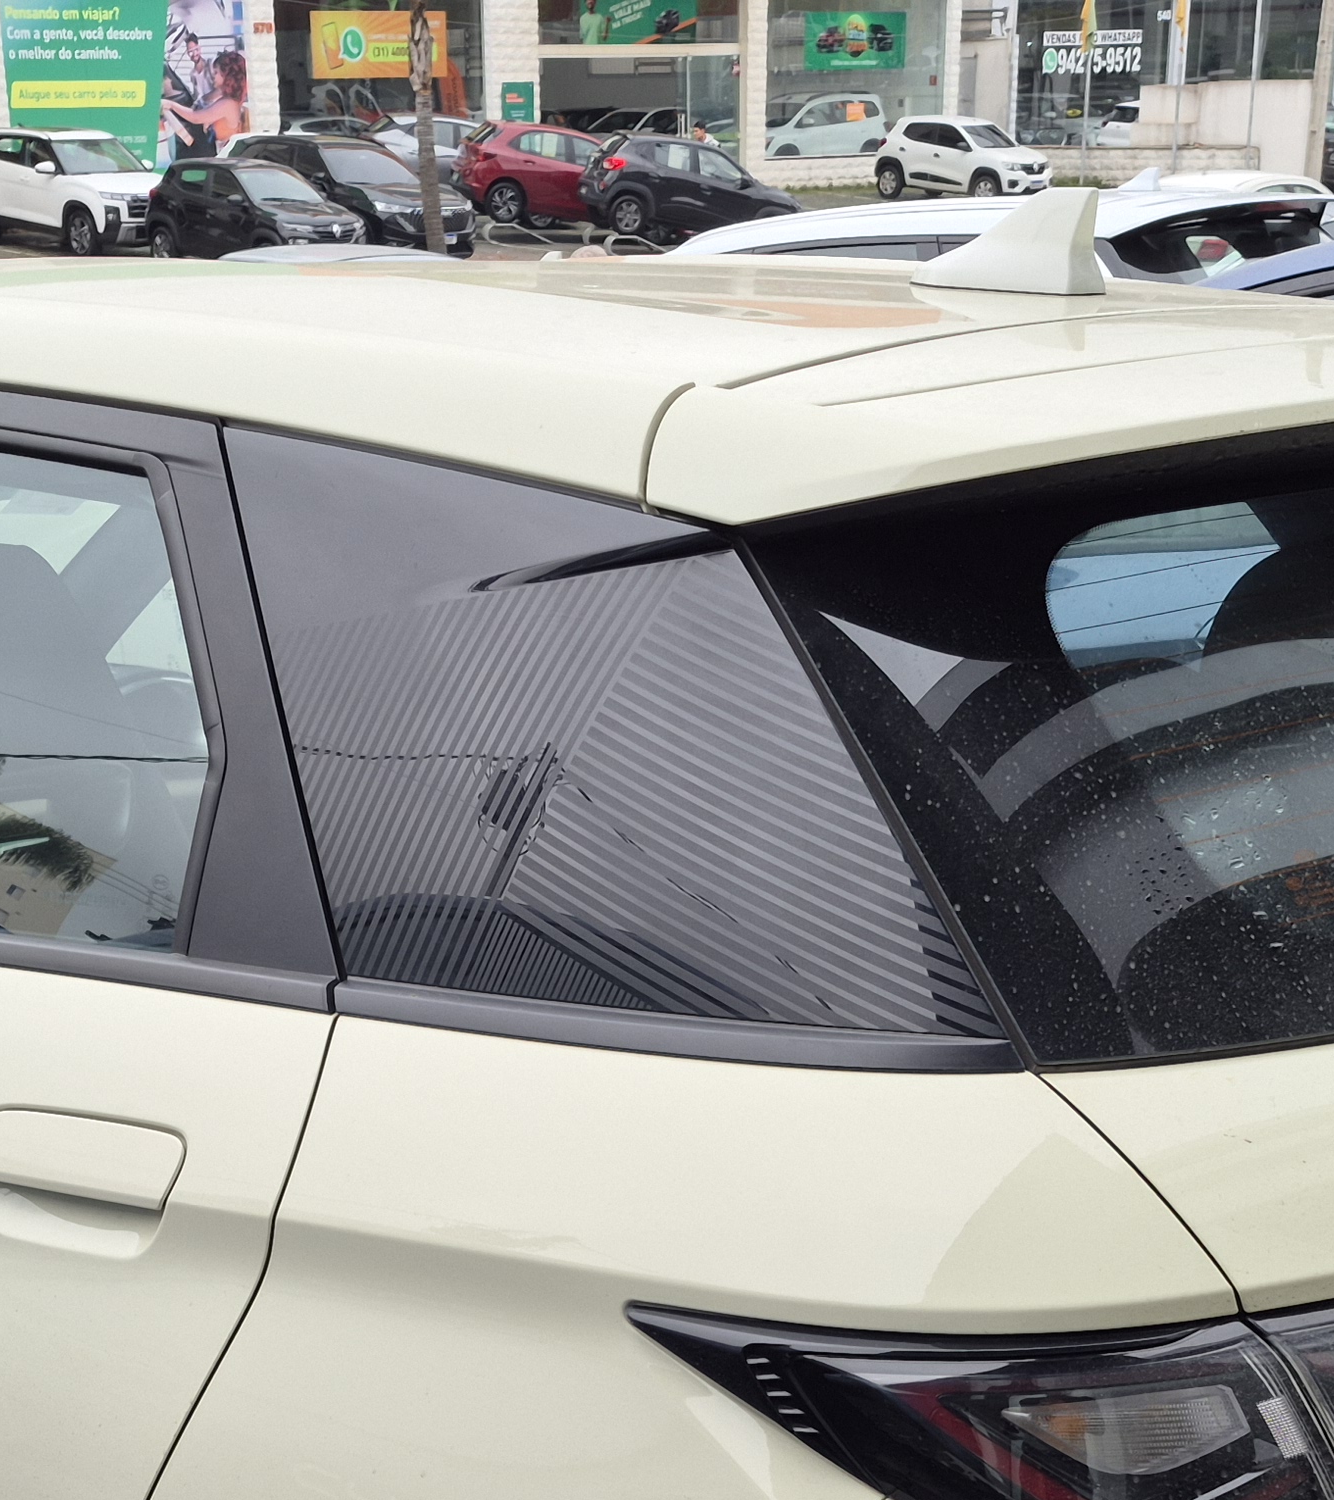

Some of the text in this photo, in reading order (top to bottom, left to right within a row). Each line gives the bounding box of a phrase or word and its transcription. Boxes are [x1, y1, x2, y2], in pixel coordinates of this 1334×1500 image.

[4, 6, 120, 23] Pensando em viajar?
[6, 26, 153, 42] Com a gente, você descobre
[1045, 33, 1077, 44] VENDAS
[1100, 31, 1141, 43] WHATSAPP
[8, 46, 122, 59] o melhor do caminho.
[1057, 46, 1142, 75] 9425-9512
[19, 89, 136, 101] Alugue seu carro pelo app
